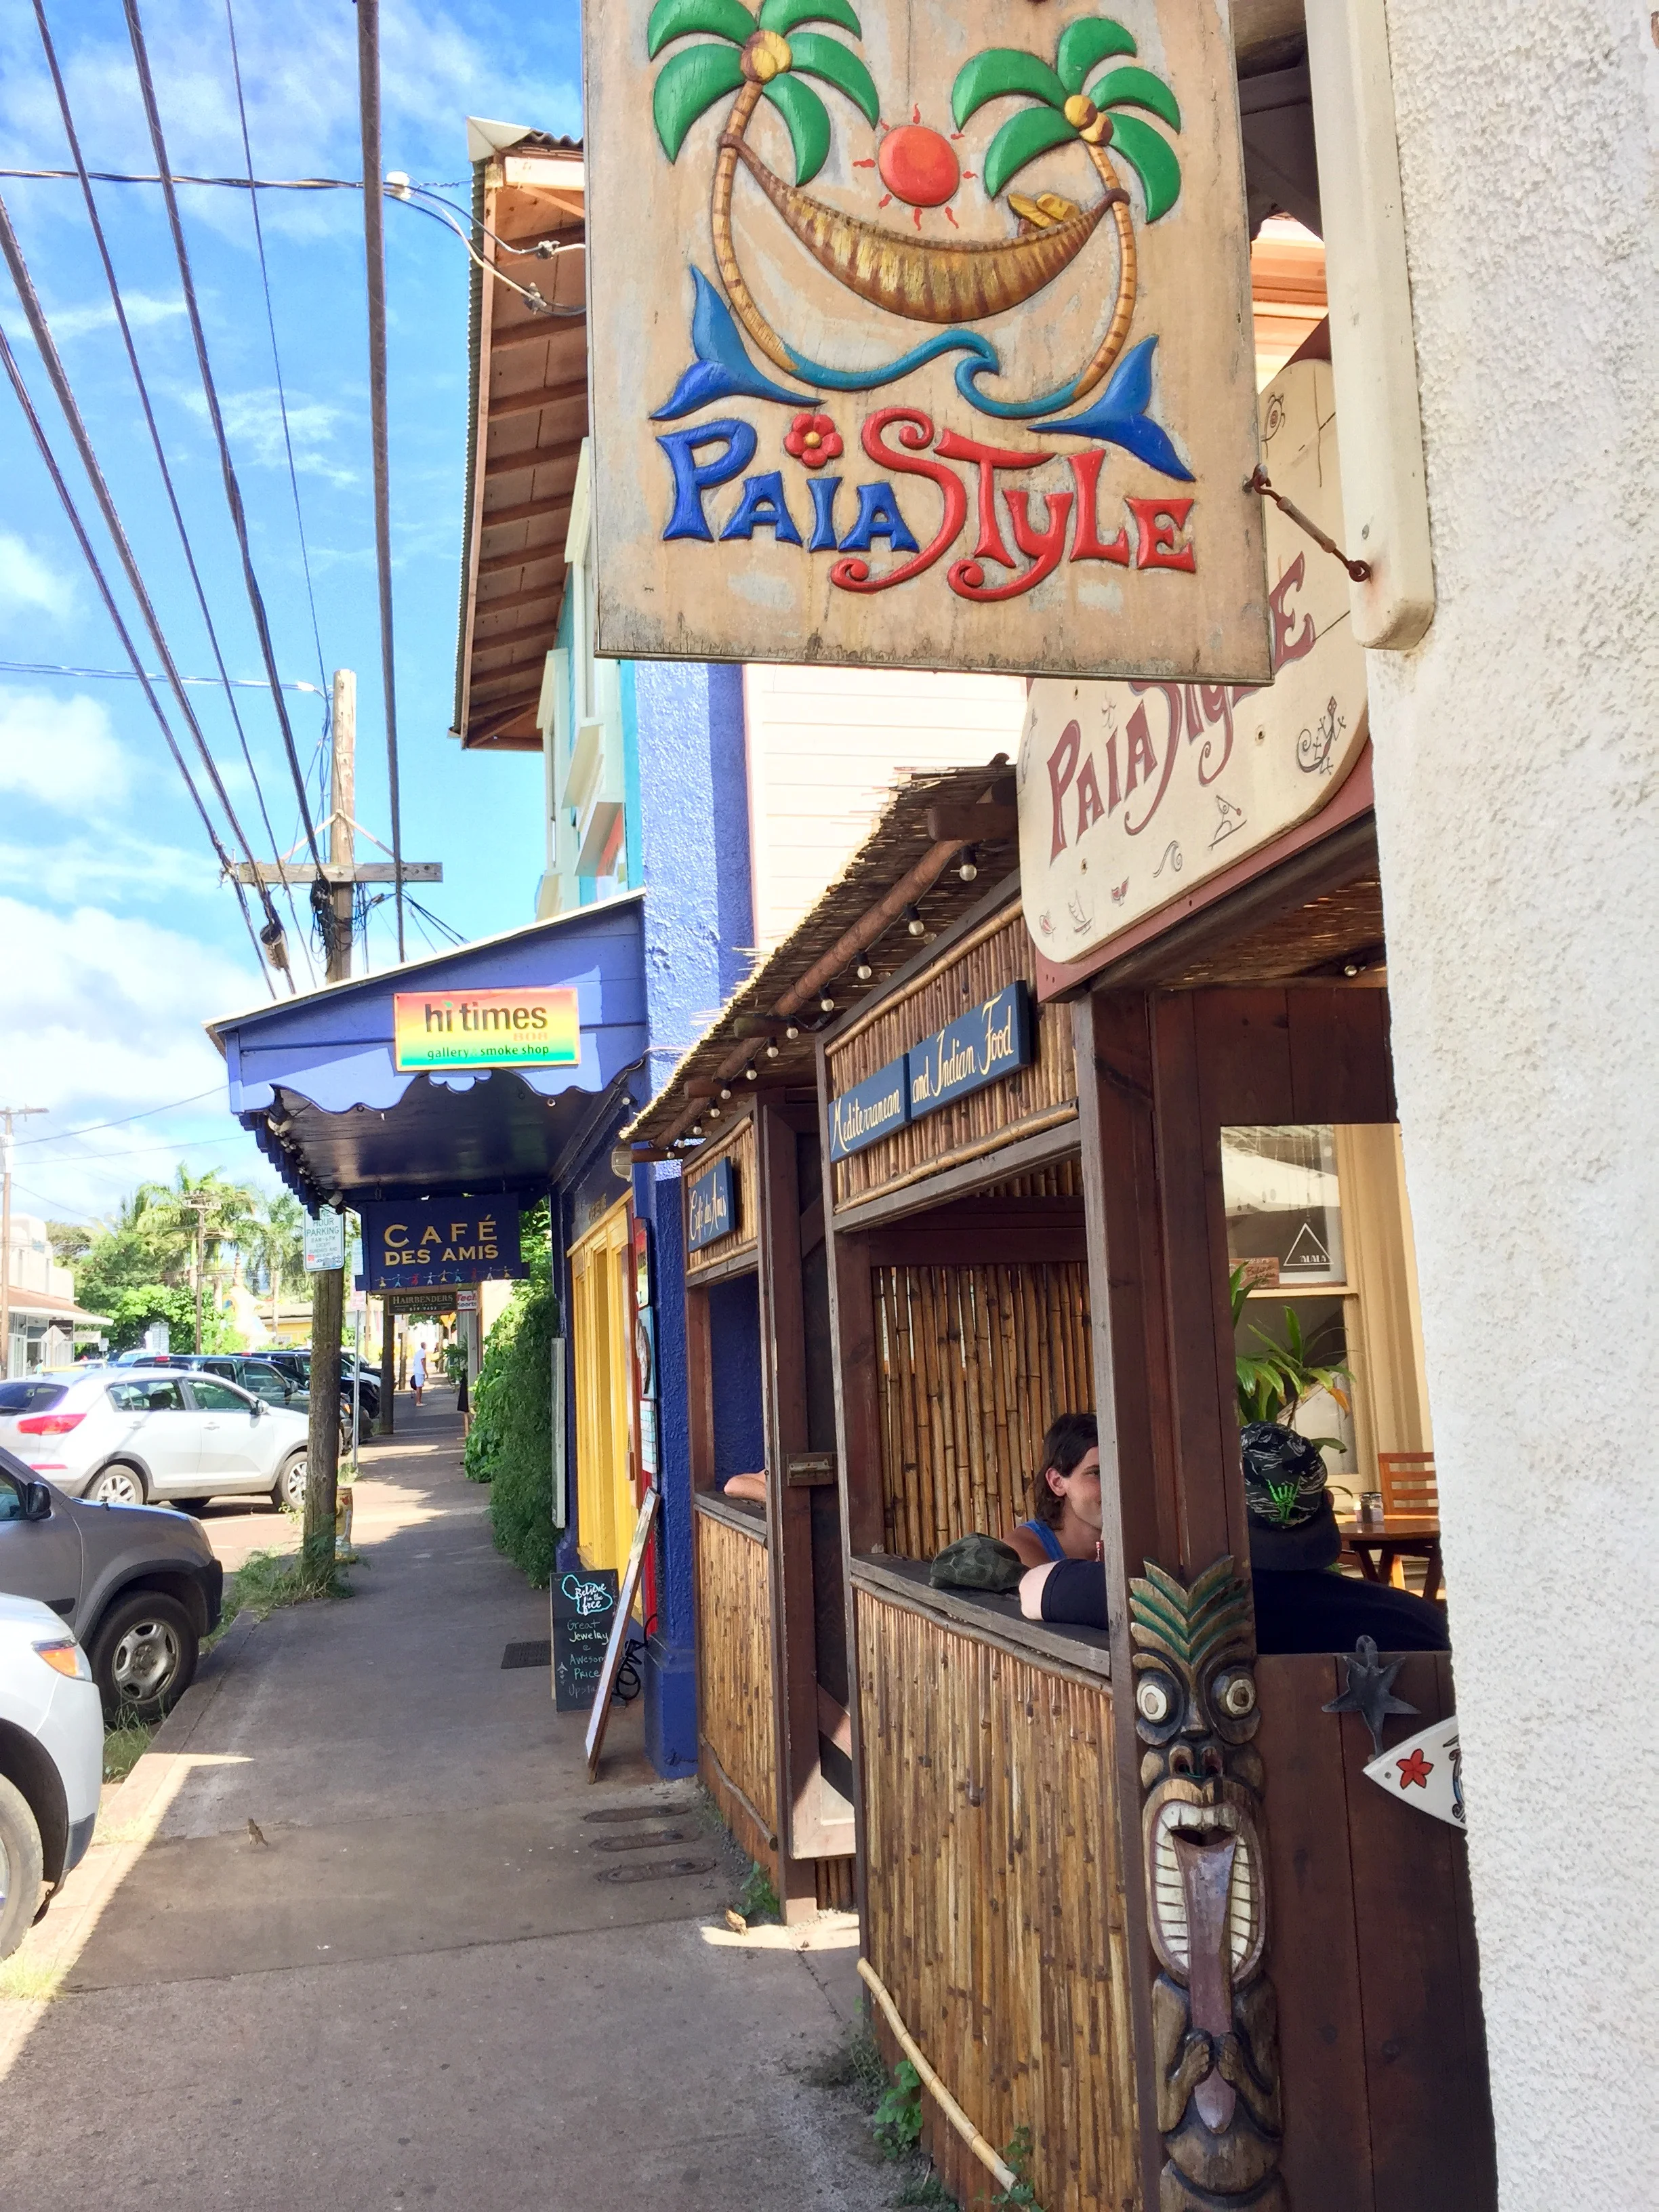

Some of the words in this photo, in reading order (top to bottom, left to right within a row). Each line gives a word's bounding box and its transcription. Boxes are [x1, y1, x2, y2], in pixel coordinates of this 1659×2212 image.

[655, 418, 920, 554] PAIA
[1046, 699, 1158, 867] PAIA
[427, 1046, 470, 1061] gallery
[830, 1088, 901, 1156] Mediterranean
[912, 1055, 930, 1104] and
[930, 1029, 977, 1097] Indian
[977, 993, 1015, 1076] Food
[313, 1218, 334, 1227] HOUR
[384, 1214, 497, 1248] CAFÉ
[306, 1226, 340, 1237] PARKING
[384, 1248, 431, 1267] DES
[441, 1244, 499, 1262] AMIS
[392, 1294, 453, 1305] HAIRBENDERS
[575, 1583, 607, 1599] Believe
[582, 1597, 602, 1616] free
[567, 1618, 600, 1631] Great
